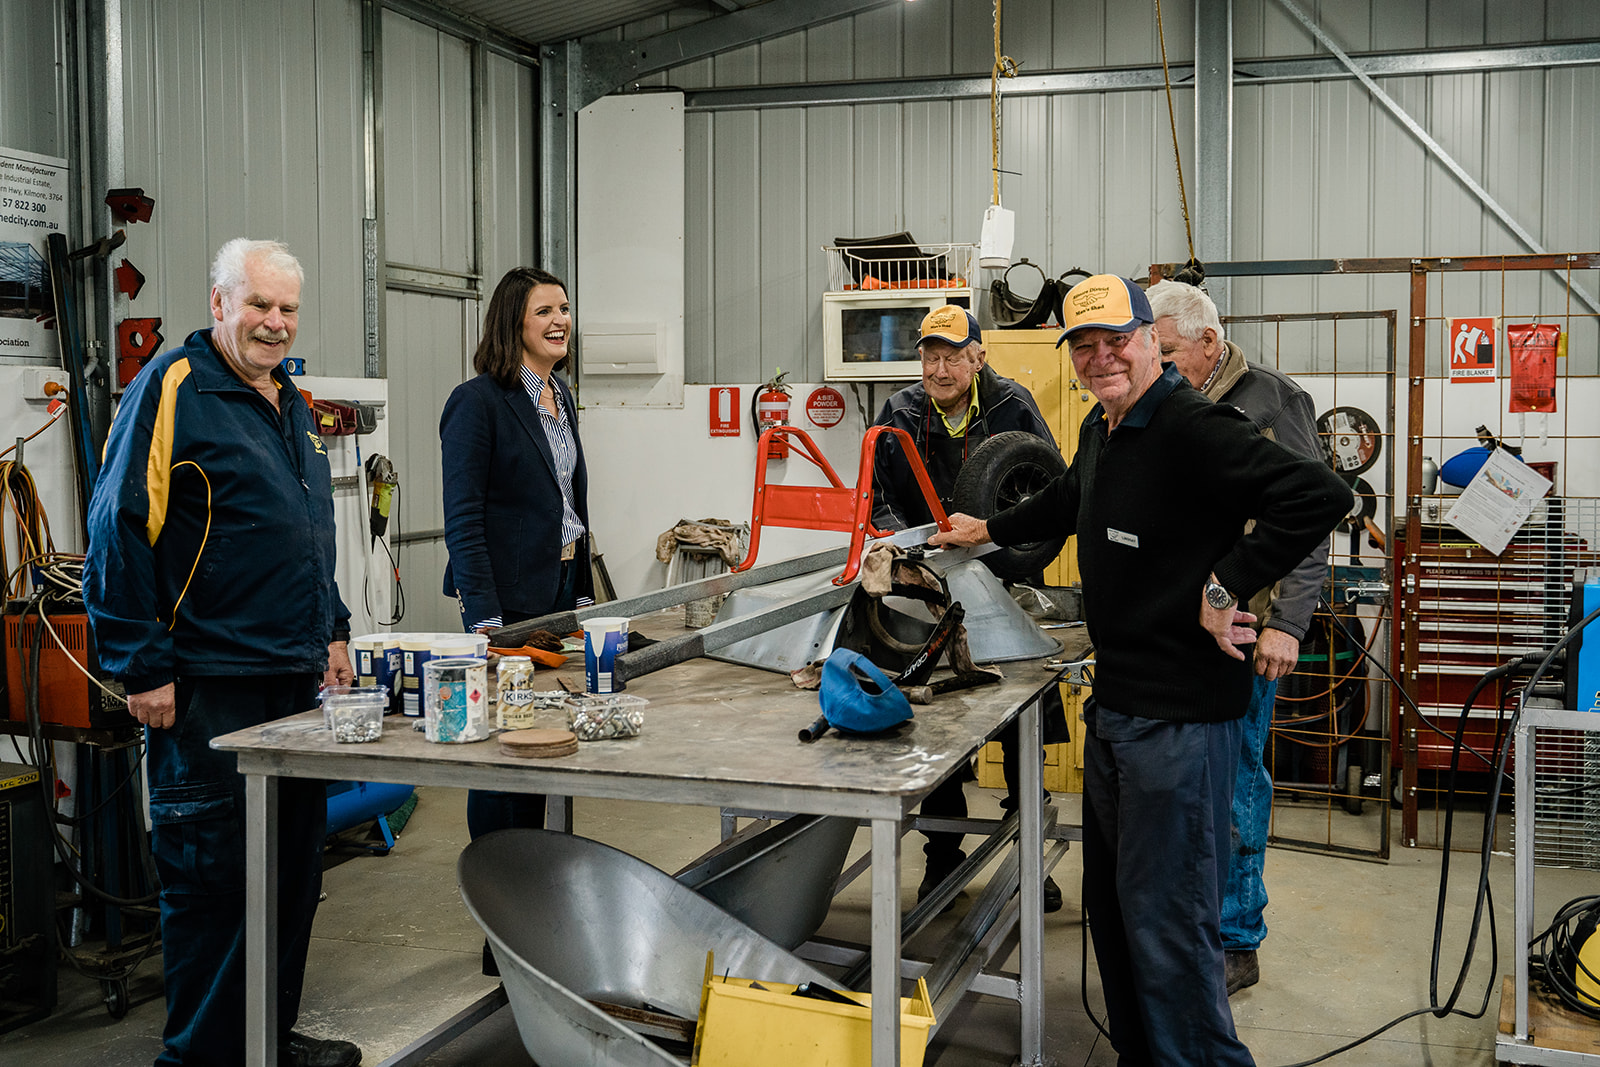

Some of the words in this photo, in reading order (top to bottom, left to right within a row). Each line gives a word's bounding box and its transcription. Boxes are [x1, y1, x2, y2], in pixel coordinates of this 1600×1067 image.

[16, 163, 56, 177] Manufacturer
[4, 173, 31, 184] Industrial
[33, 179, 52, 189] Estate,
[49, 193, 63, 201] 3764
[3, 198, 12, 208] 57
[15, 200, 29, 210] 822
[32, 203, 46, 213] 300
[506, 691, 533, 702] KIRKS
[18, 773, 37, 784] 200
